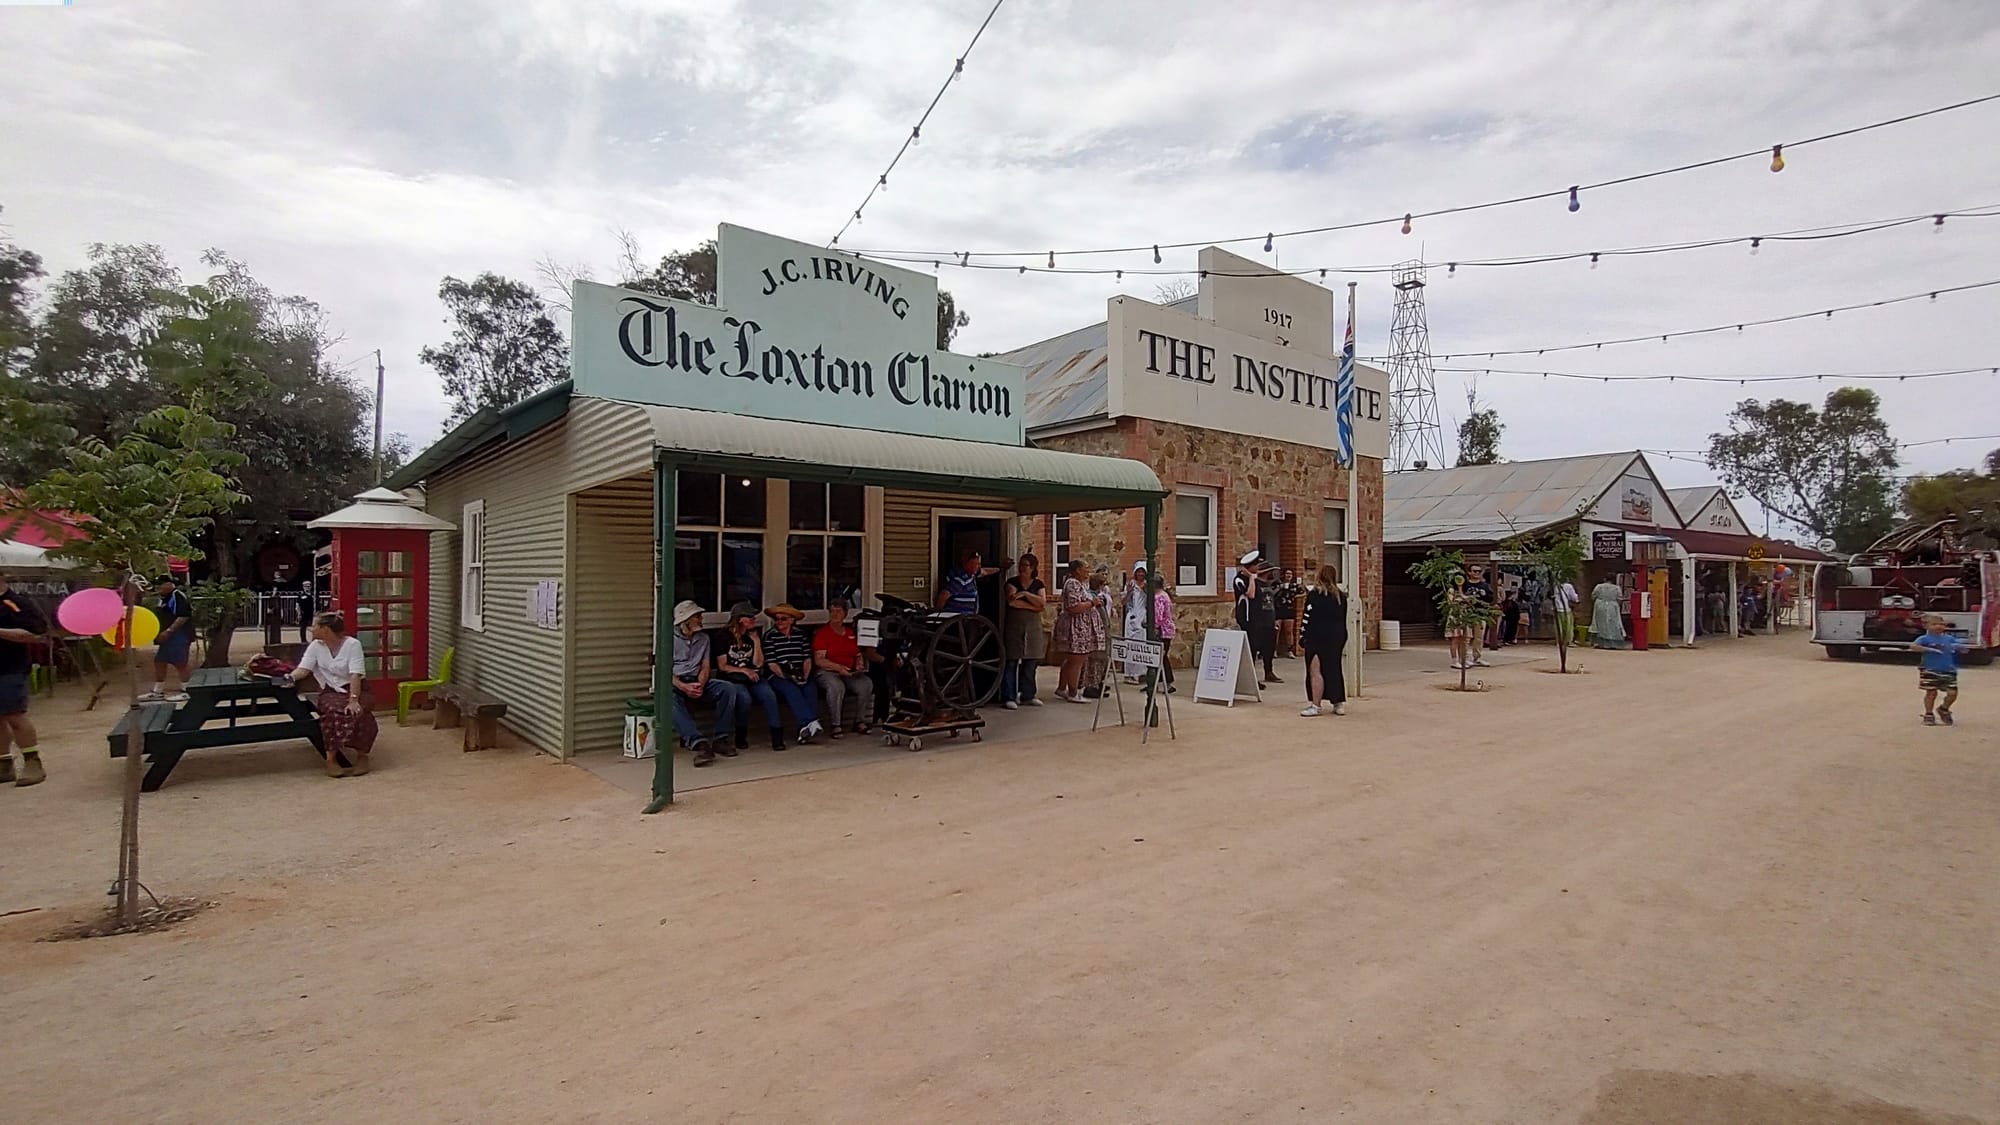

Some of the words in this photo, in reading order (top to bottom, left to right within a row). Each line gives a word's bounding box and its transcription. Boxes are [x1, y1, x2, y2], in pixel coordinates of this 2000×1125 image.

[813, 256, 910, 320] IRVING
[1263, 307, 1293, 330] 1917
[617, 296, 716, 376] The
[720, 316, 875, 398] Loxton
[887, 351, 1012, 418] Clarion
[1138, 329, 1217, 384] THE
[1232, 353, 1382, 421] INSTITTE
